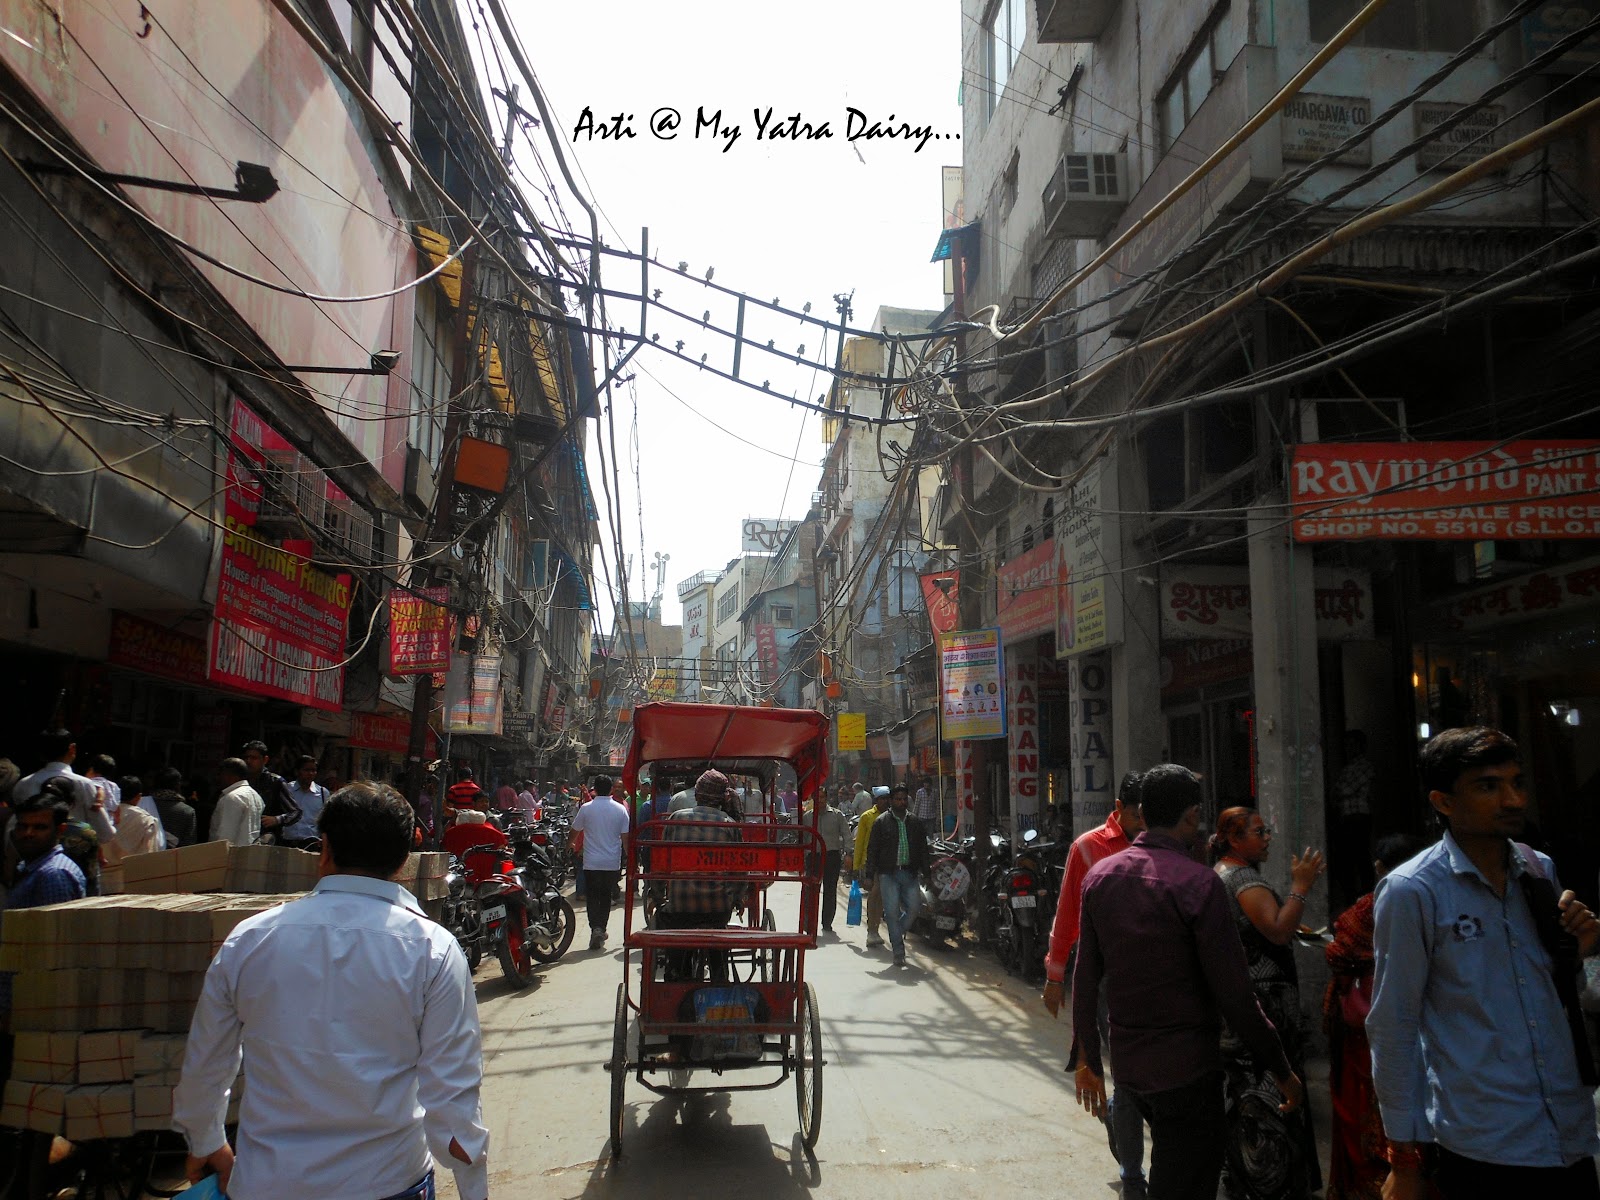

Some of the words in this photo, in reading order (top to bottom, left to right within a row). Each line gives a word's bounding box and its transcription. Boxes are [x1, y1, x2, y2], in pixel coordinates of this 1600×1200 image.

[1284, 102, 1346, 123] BHARGAVA
[1352, 107, 1370, 125] CO.
[1531, 447, 1587, 471] SUIT
[1293, 447, 1521, 505] Raymond
[1525, 473, 1587, 496] PANT
[1342, 506, 1510, 521] WHOLESALE
[1300, 523, 1373, 537] SHOP
[1381, 522, 1427, 536] NO.
[1434, 521, 1497, 535] 5516
[223, 515, 298, 581] SANJANA
[300, 561, 348, 609] FABRICS
[223, 558, 250, 585] House
[250, 575, 260, 591] of
[260, 577, 291, 606] Designer
[395, 617, 446, 634] FABRICS
[396, 633, 427, 643] DEALS
[399, 642, 441, 653] FANCY
[393, 651, 448, 663] FABRICS
[1017, 663, 1038, 797] NARANG
[1070, 666, 1080, 793] OPAL
[1082, 664, 1110, 793] OPAL
